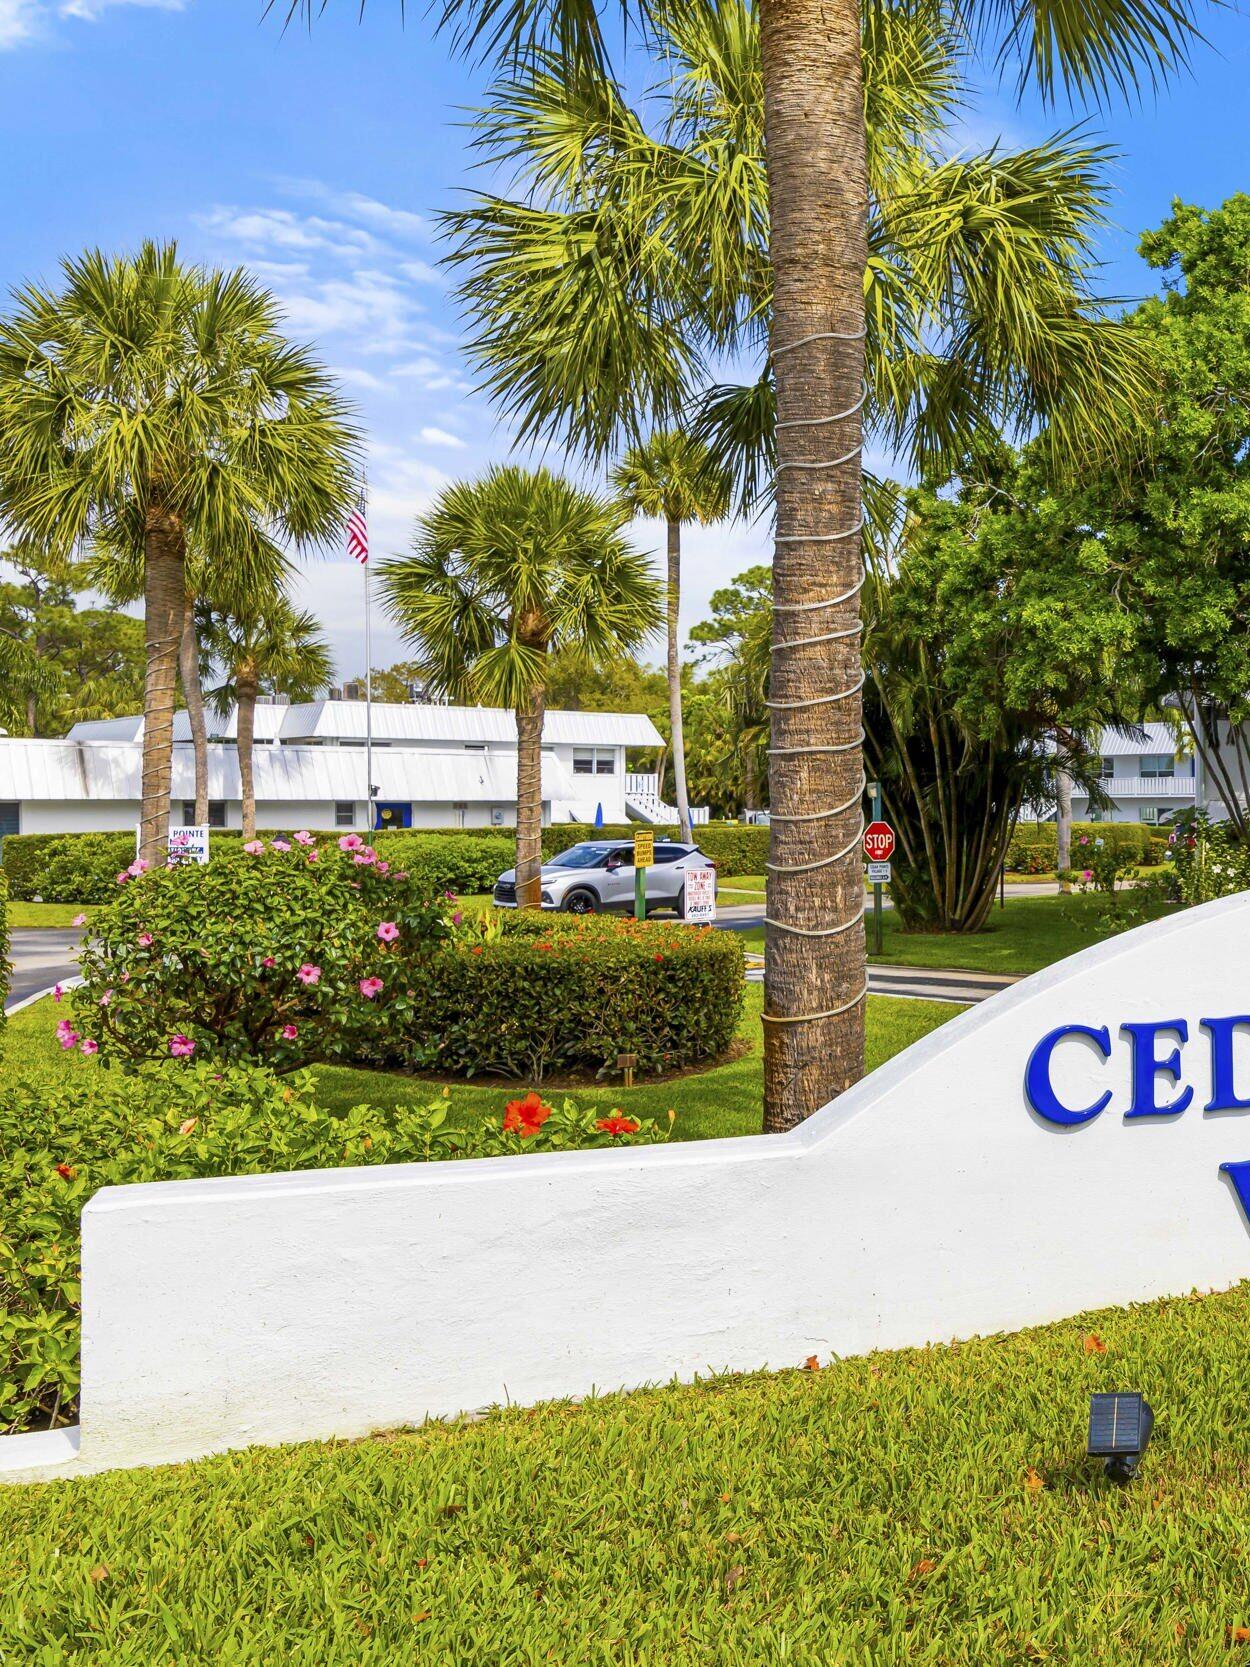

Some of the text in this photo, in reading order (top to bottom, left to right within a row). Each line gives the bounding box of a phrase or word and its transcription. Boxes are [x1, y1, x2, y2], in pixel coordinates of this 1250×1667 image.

[866, 834, 892, 849] STOP
[688, 871, 712, 881] TOW AWAY
[694, 881, 706, 890] ZONE
